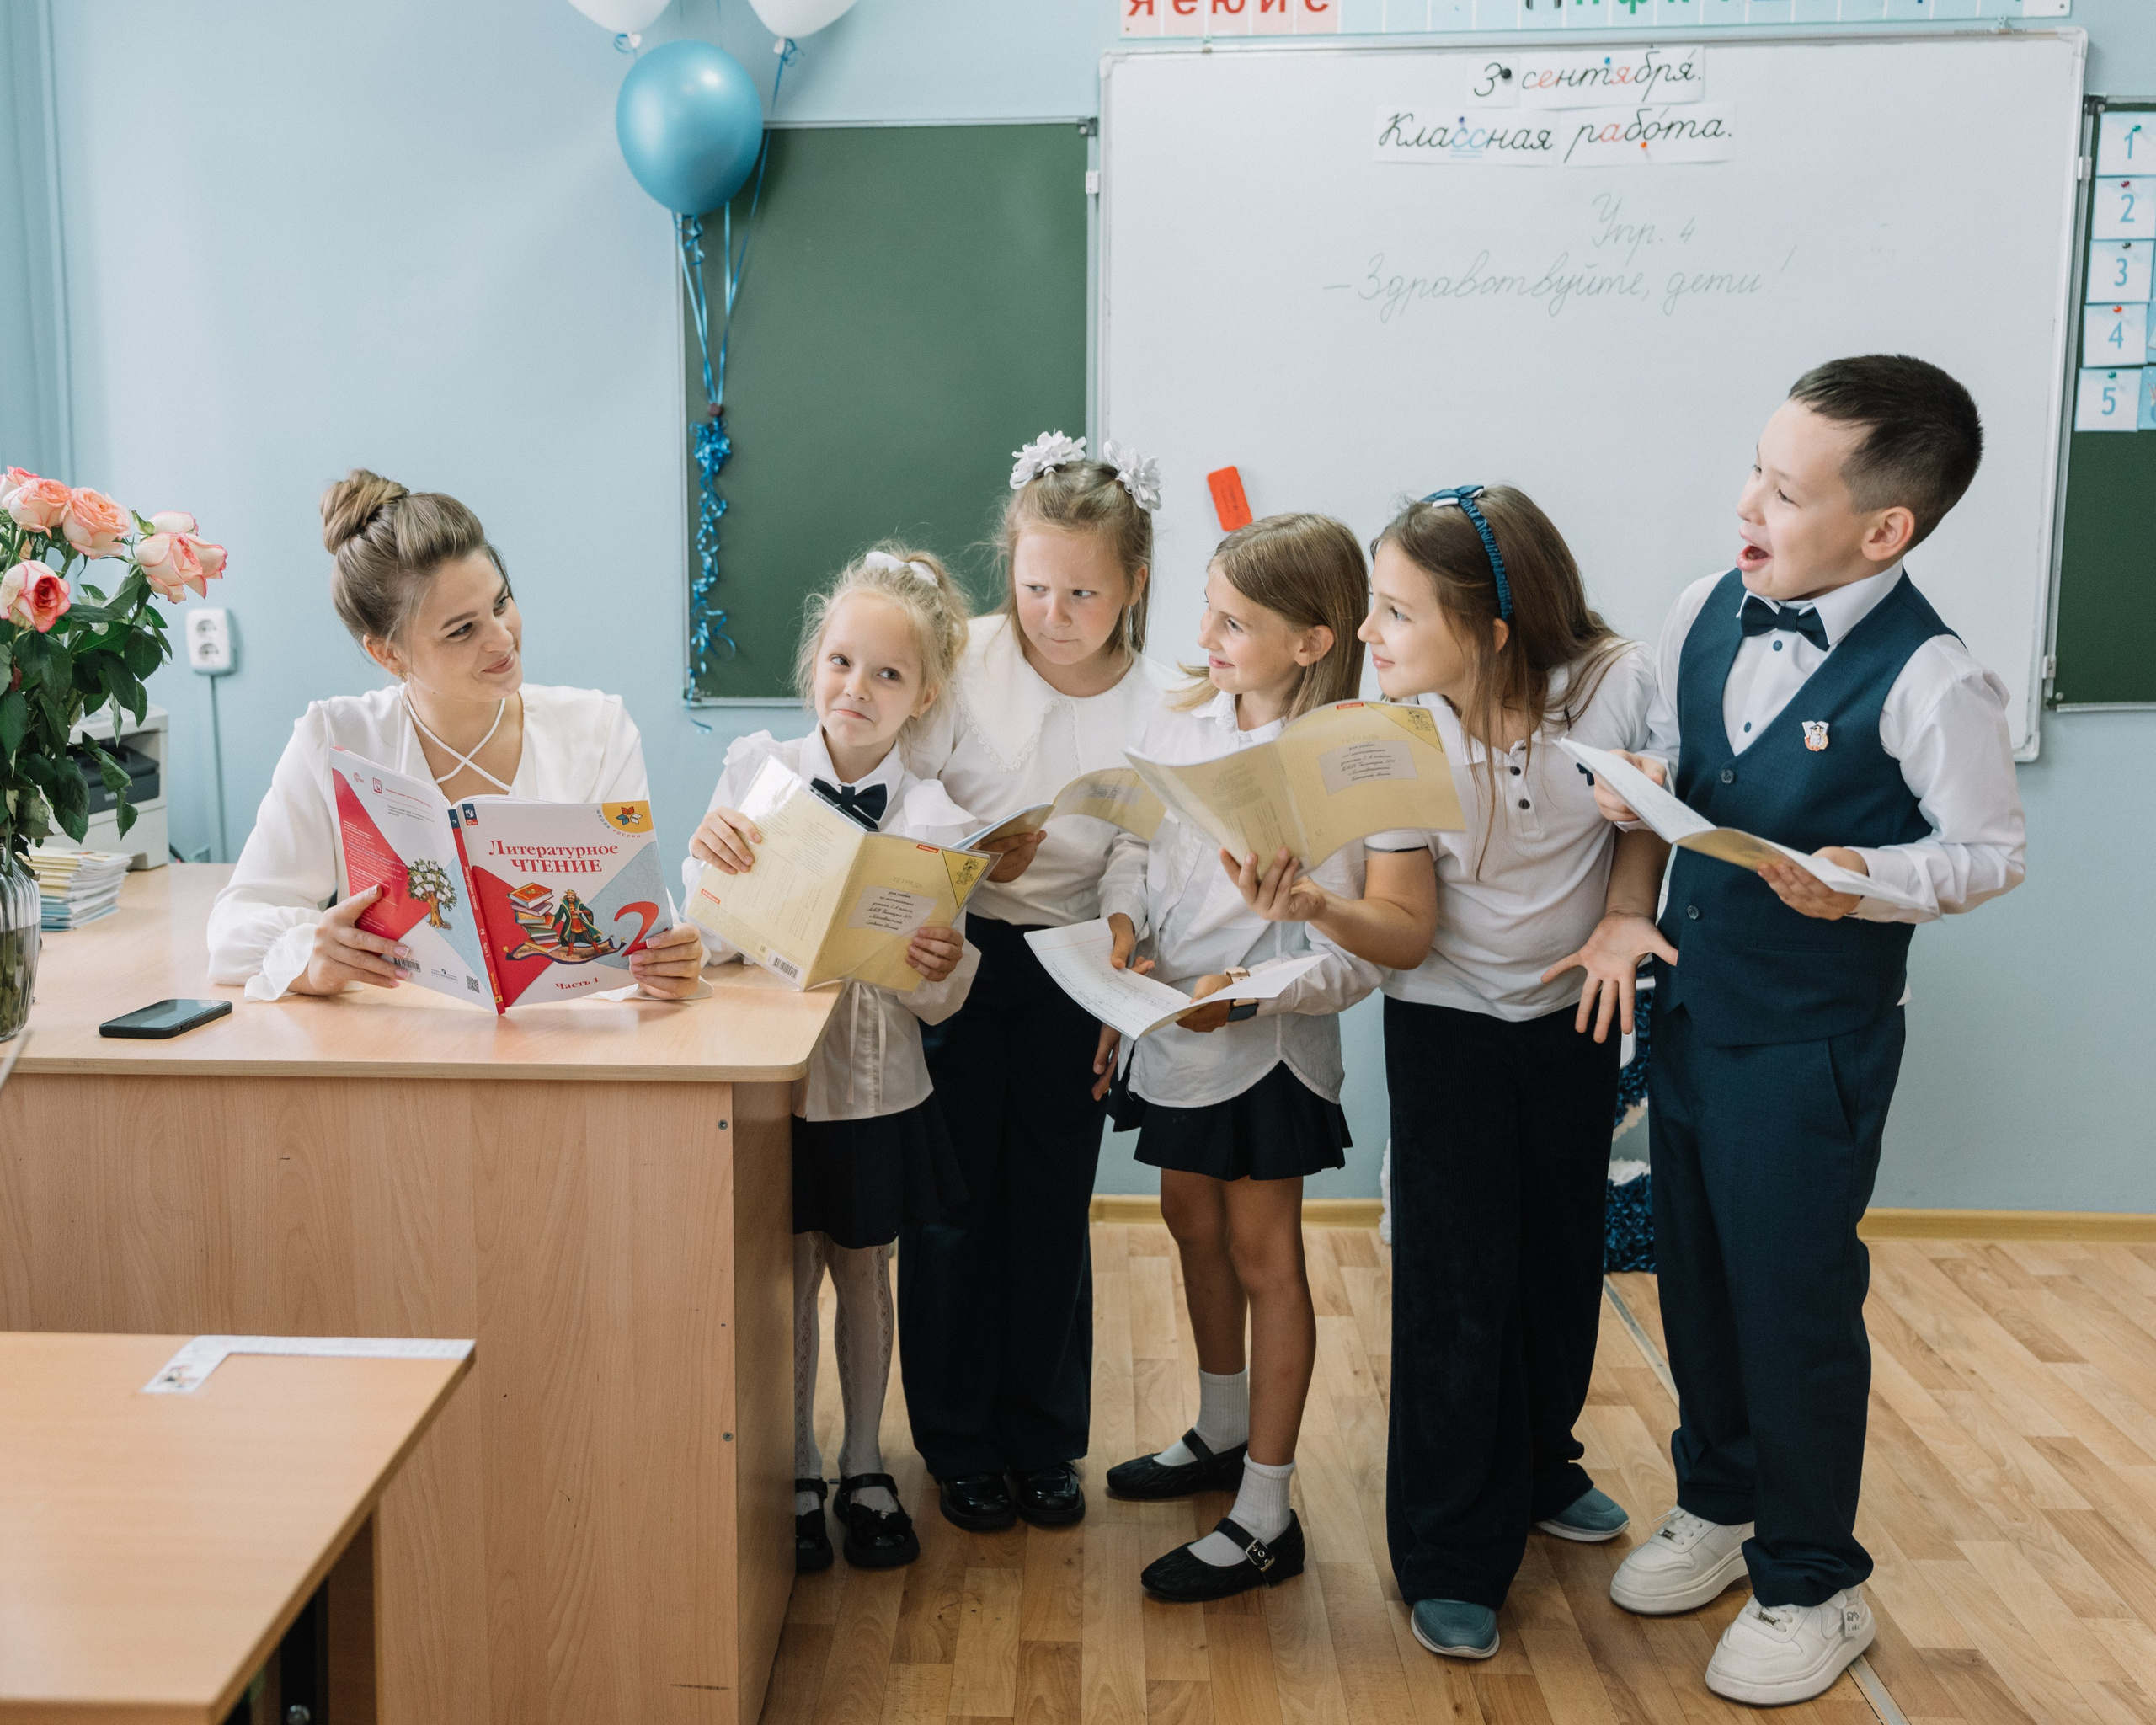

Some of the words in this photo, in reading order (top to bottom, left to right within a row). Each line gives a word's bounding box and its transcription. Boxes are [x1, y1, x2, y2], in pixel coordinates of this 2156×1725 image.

[1474, 61, 1503, 98] 3
[1378, 112, 1554, 152] Классная
[2123, 131, 2135, 160] 1
[2119, 193, 2136, 223] 2
[1591, 193, 1665, 267] Упр.
[2114, 257, 2129, 287] 3
[2108, 320, 2124, 350] 4
[2101, 387, 2116, 416] 5
[596, 809, 611, 829] ШКОЛА
[612, 829, 641, 838] РОССИИ
[488, 840, 619, 859] Литературное
[510, 858, 603, 873] ЧТЕНИЕ
[613, 900, 659, 958] 2
[555, 980, 591, 991] Часть
